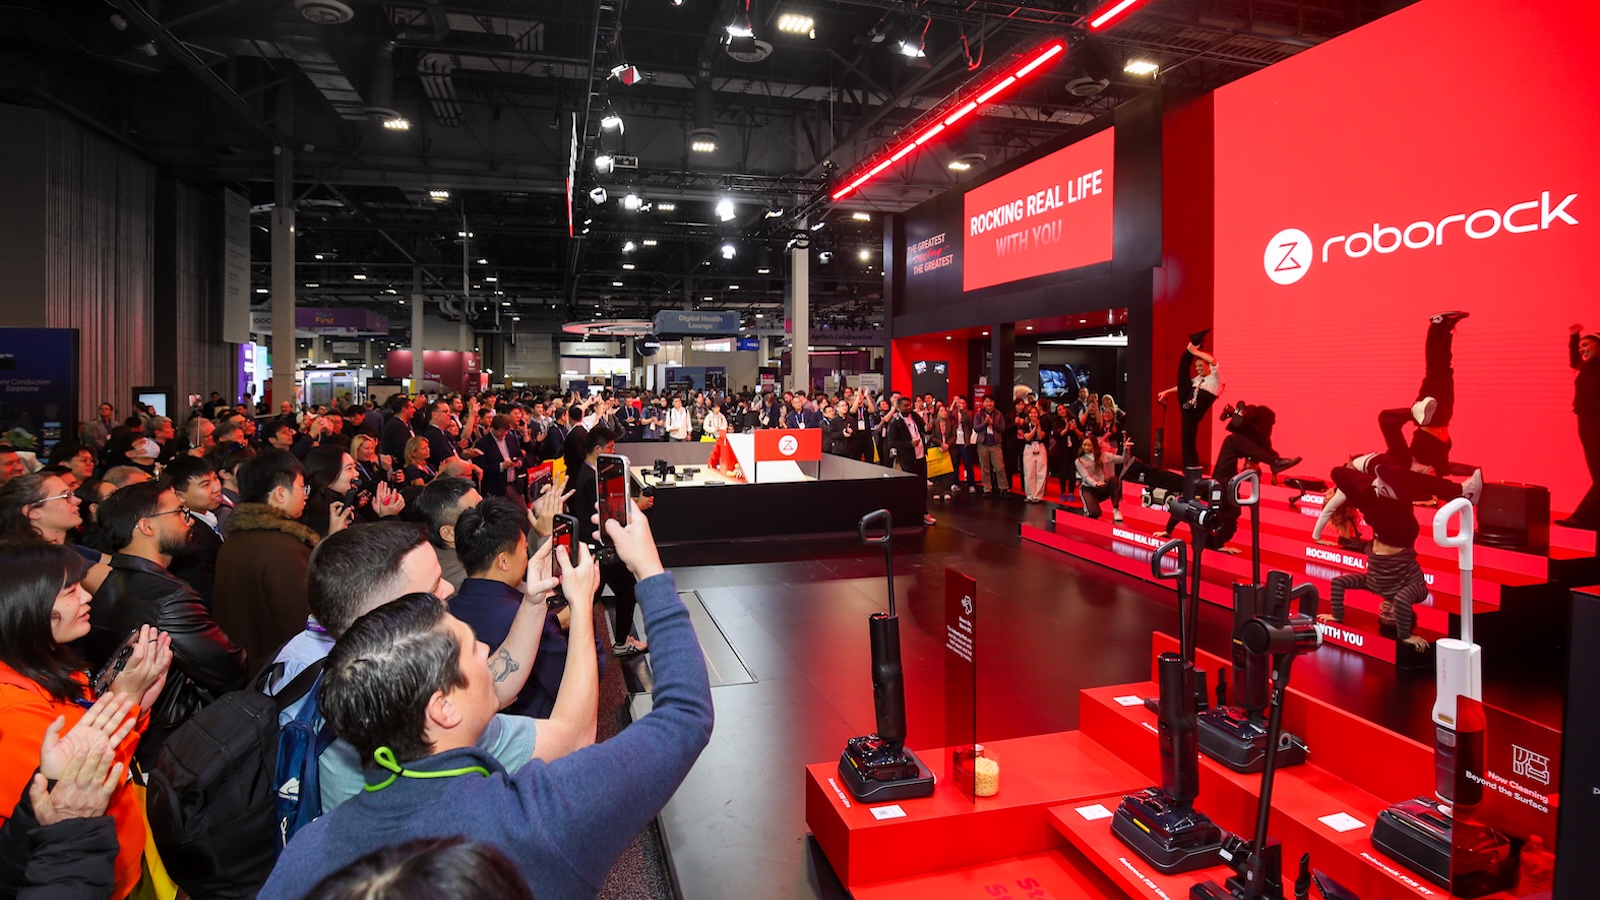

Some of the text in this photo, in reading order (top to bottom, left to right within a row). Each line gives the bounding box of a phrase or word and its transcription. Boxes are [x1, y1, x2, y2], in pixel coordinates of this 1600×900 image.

[970, 169, 1103, 237] ROCKING REAL LIFE
[1321, 190, 1580, 263] roborock
[907, 232, 946, 254] THE GREATEST
[995, 219, 1062, 258] WITH YOU
[913, 253, 954, 276] THE GREATEST
[315, 316, 334, 324] First
[678, 314, 723, 323] Digital Health
[687, 322, 713, 331] Lounge
[811, 333, 873, 341] AgeTech Collaborative
[5, 385, 40, 393] Earphone
[1112, 527, 1135, 541] ROCKING
[1134, 532, 1149, 545] REAL
[1148, 536, 1160, 548] LIFE
[1305, 546, 1365, 570] ROCKING REAL
[1316, 621, 1364, 647] WITH YOU
[1465, 769, 1549, 814] Beyond the Surface
[1487, 770, 1549, 805] Now Cleaning
[1118, 857, 1145, 880] Roborock
[1360, 852, 1400, 877] Roborock
